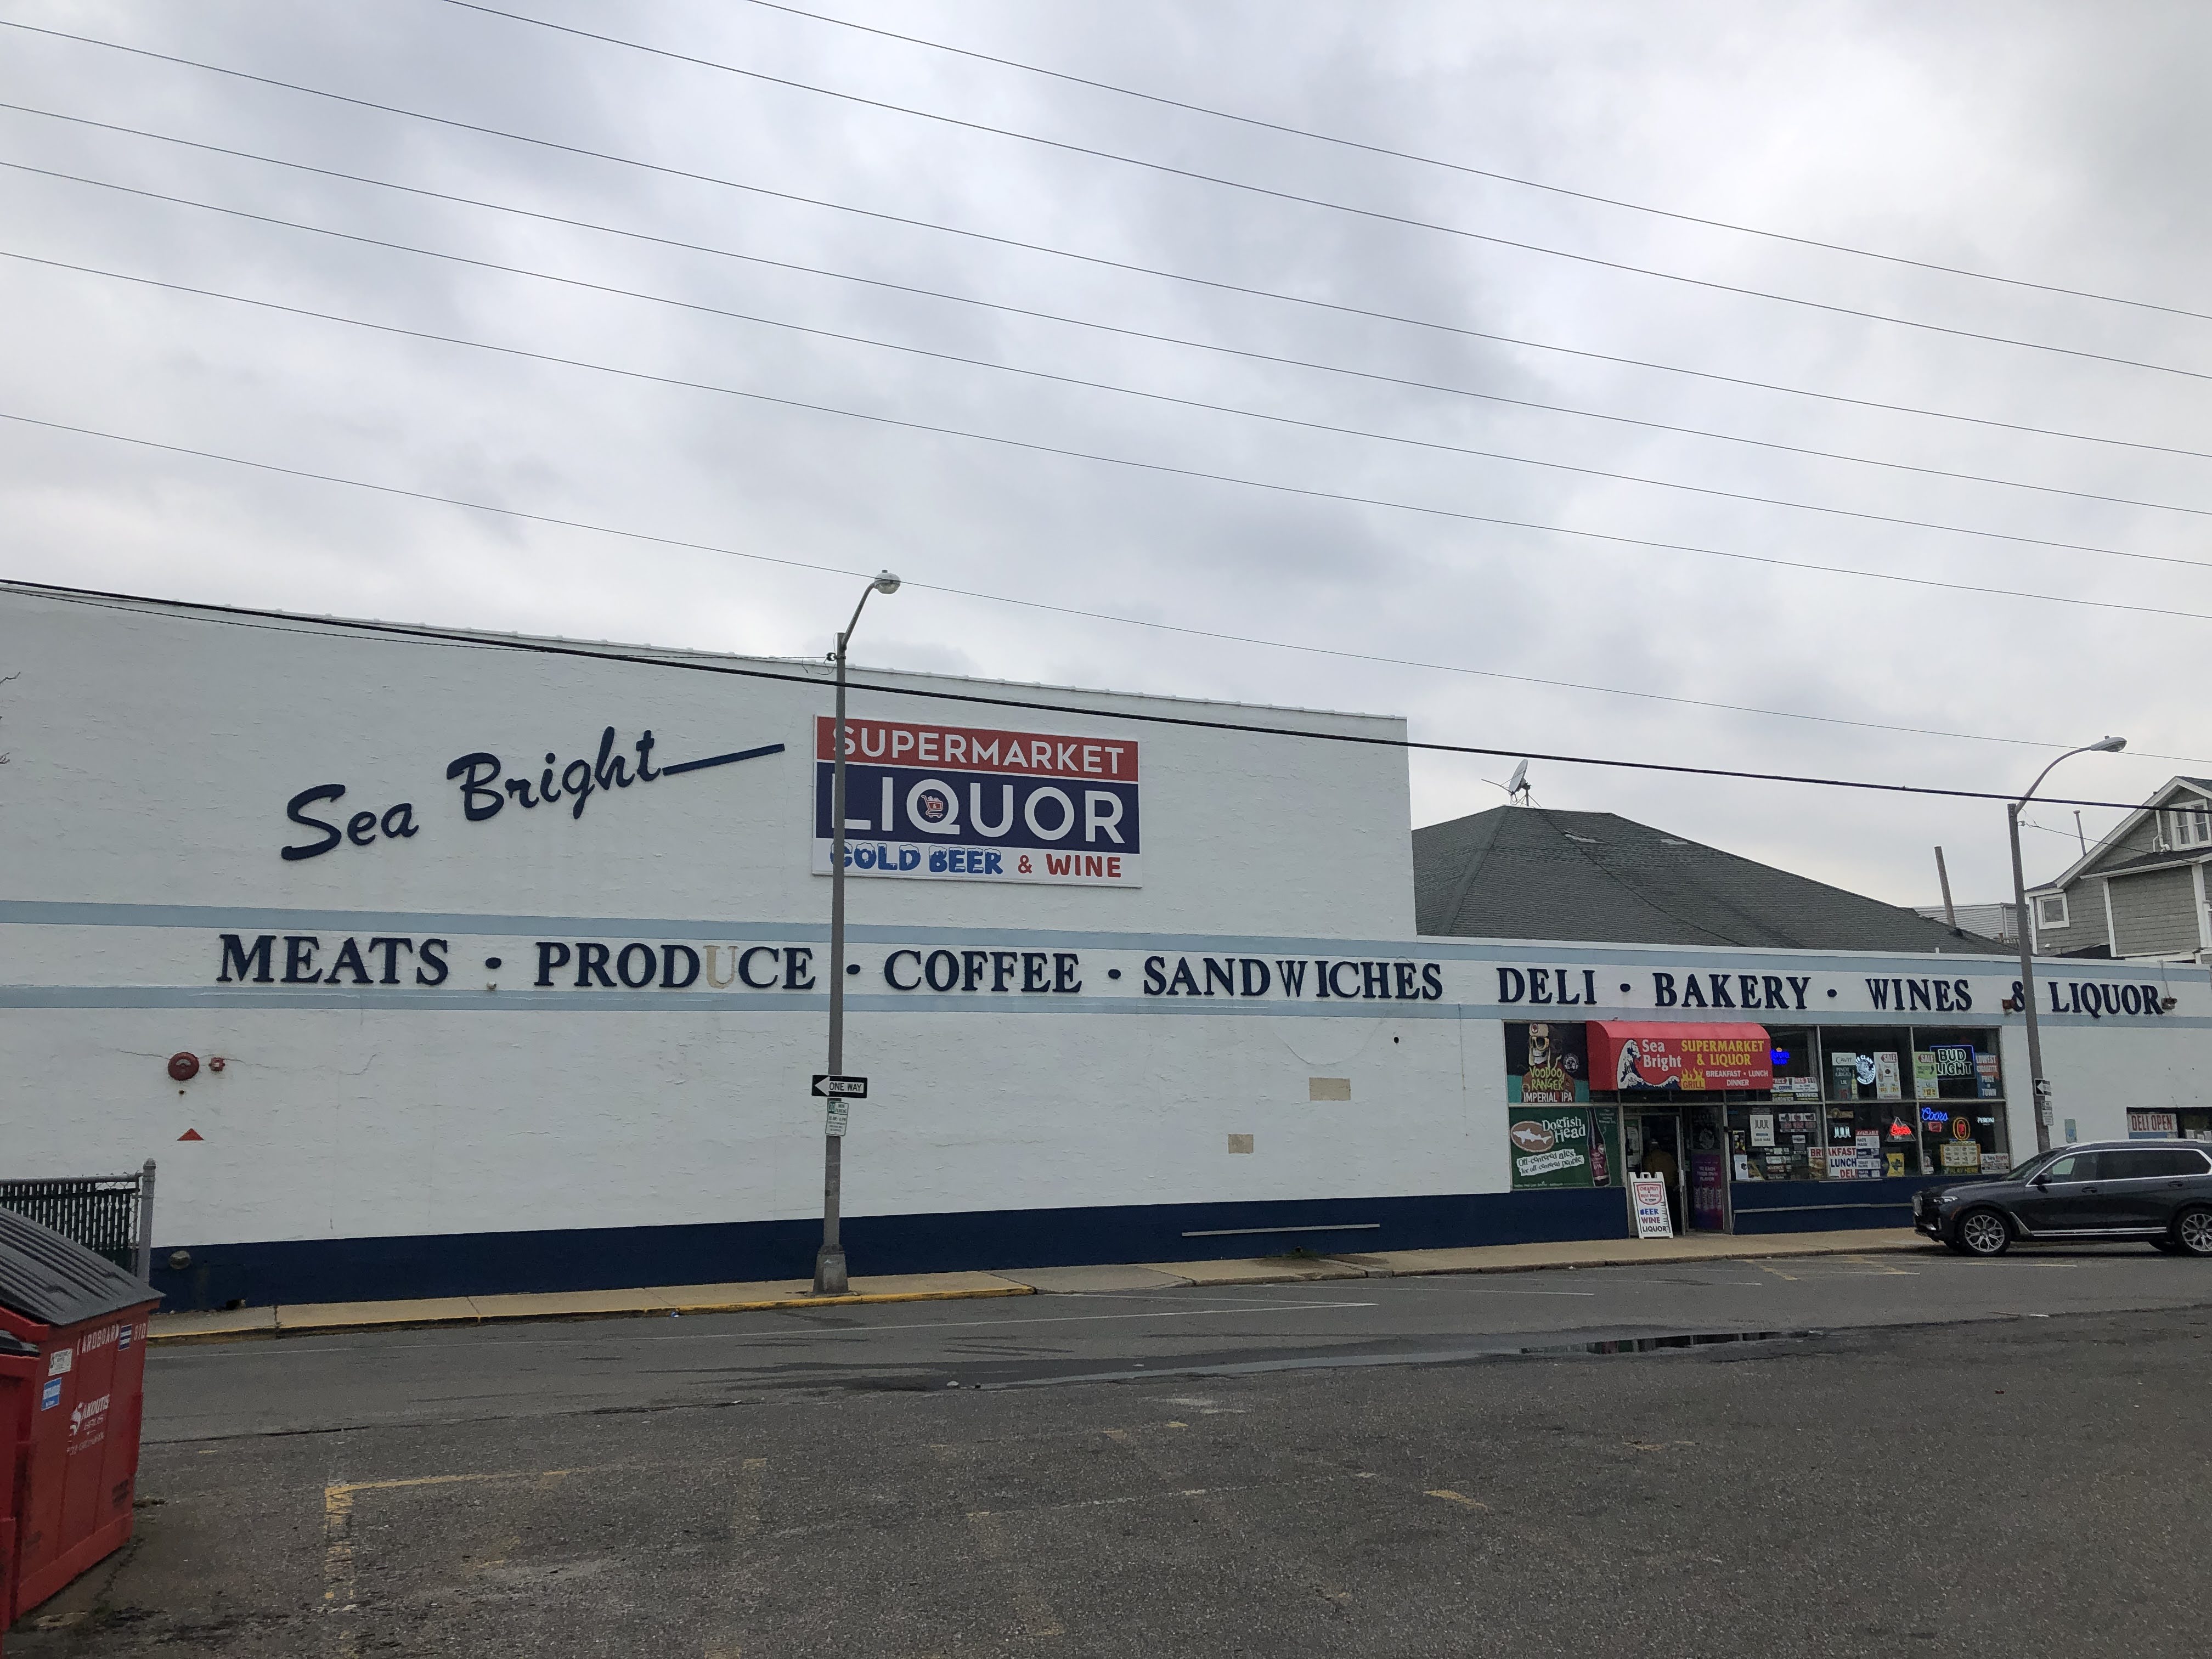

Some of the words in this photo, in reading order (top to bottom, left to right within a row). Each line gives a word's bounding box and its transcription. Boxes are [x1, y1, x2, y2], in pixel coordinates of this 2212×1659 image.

[833, 727, 1125, 775] SUPERMARKET
[281, 784, 419, 861] Sea
[446, 726, 662, 821] Bright
[832, 773, 1125, 844] LIQUOR
[830, 842, 921, 872] COLD
[929, 845, 1003, 875] BEER
[1018, 854, 1032, 874] &
[1046, 854, 1121, 878] WINE
[216, 934, 449, 986] MEATS
[534, 941, 816, 989] PRODUCE
[883, 949, 1082, 993] COFFEE
[1143, 956, 1443, 1001] SANDWICHES
[1497, 967, 1598, 1005] DELI
[1653, 972, 1812, 1011] BAKERY
[1865, 978, 1972, 1012] WINES
[2047, 981, 2165, 1018] LIQUOR
[1642, 1040, 1665, 1052] Sea
[1681, 1040, 1764, 1052] SUPERMARKET
[1696, 1054, 1705, 1065] &
[1710, 1054, 1752, 1067] LIQUOR
[1884, 1054, 1896, 1063] SALE
[1921, 1054, 1934, 1063] SALE
[1938, 1048, 1966, 1062] BUD
[1643, 1054, 1681, 1071] Bright
[1936, 1062, 1972, 1076] LIGHT
[1530, 1066, 1563, 1079] VOODOO
[829, 1082, 844, 1091] ONE
[847, 1083, 862, 1092] WAY
[1531, 1078, 1563, 1091] RANGER
[1683, 1080, 1705, 1089] GRILL
[1523, 1092, 1558, 1103] IMPERIAL
[1561, 1092, 1573, 1102] IPA
[1921, 1107, 1948, 1121] Coors
[1542, 1116, 1581, 1131] Dogfish
[2131, 1115, 2149, 1131] DELI
[2151, 1114, 2173, 1131] OPEN
[1554, 1124, 1585, 1143] Head
[1831, 1158, 1857, 1168] LUNCH
[1840, 1169, 1858, 1178] DELI
